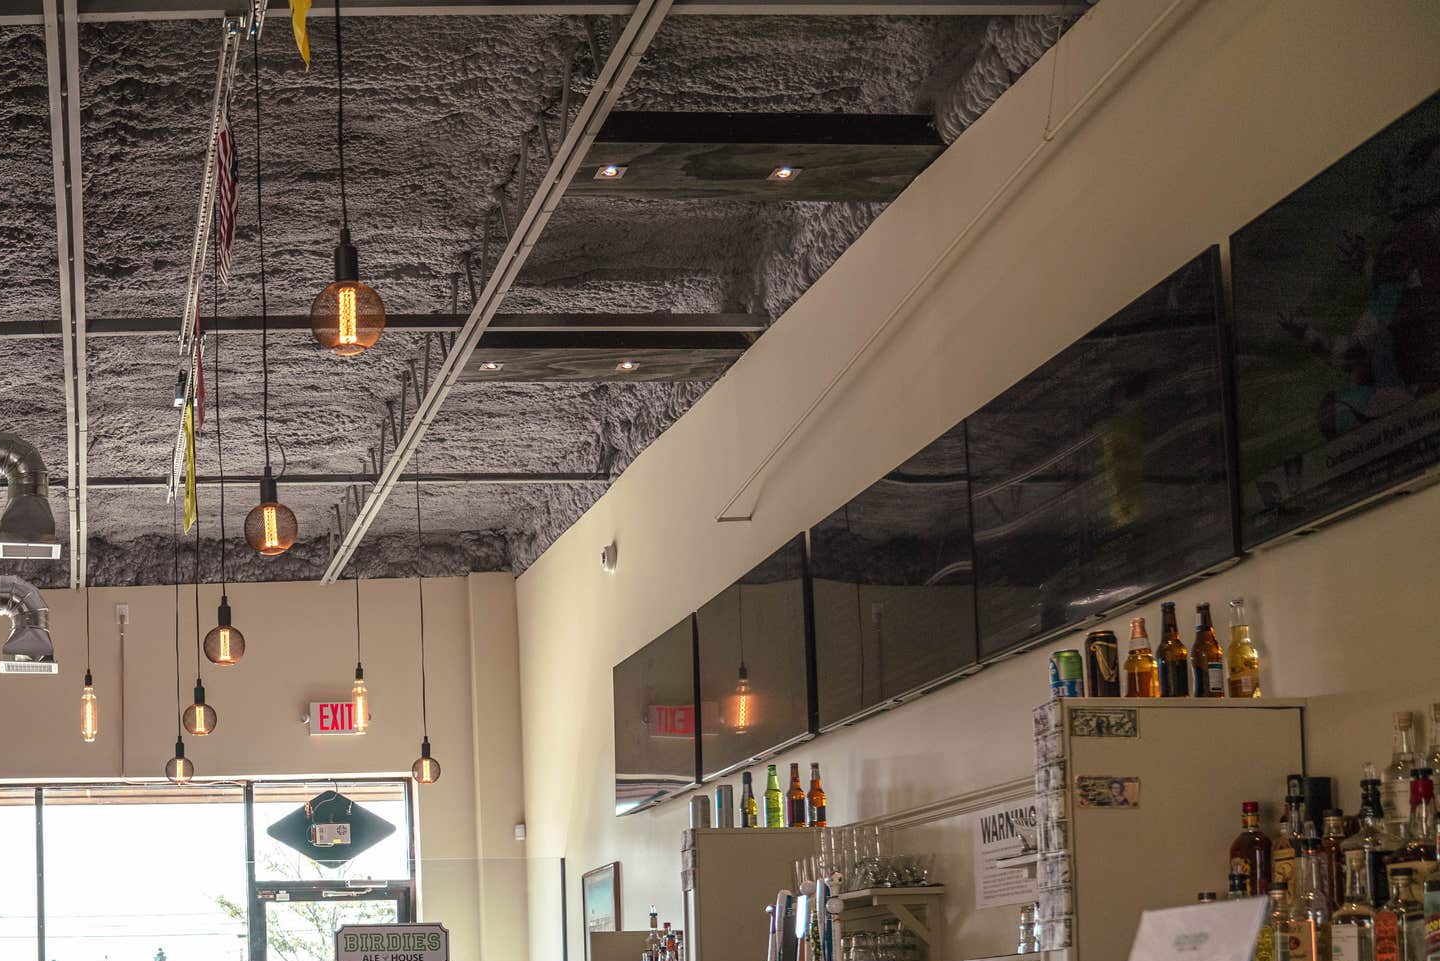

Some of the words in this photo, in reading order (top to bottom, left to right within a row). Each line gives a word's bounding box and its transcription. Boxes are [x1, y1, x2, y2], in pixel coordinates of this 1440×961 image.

[319, 703, 353, 731] EXIT
[344, 932, 441, 953] BIRDIES
[391, 953, 424, 961] HOUSE
